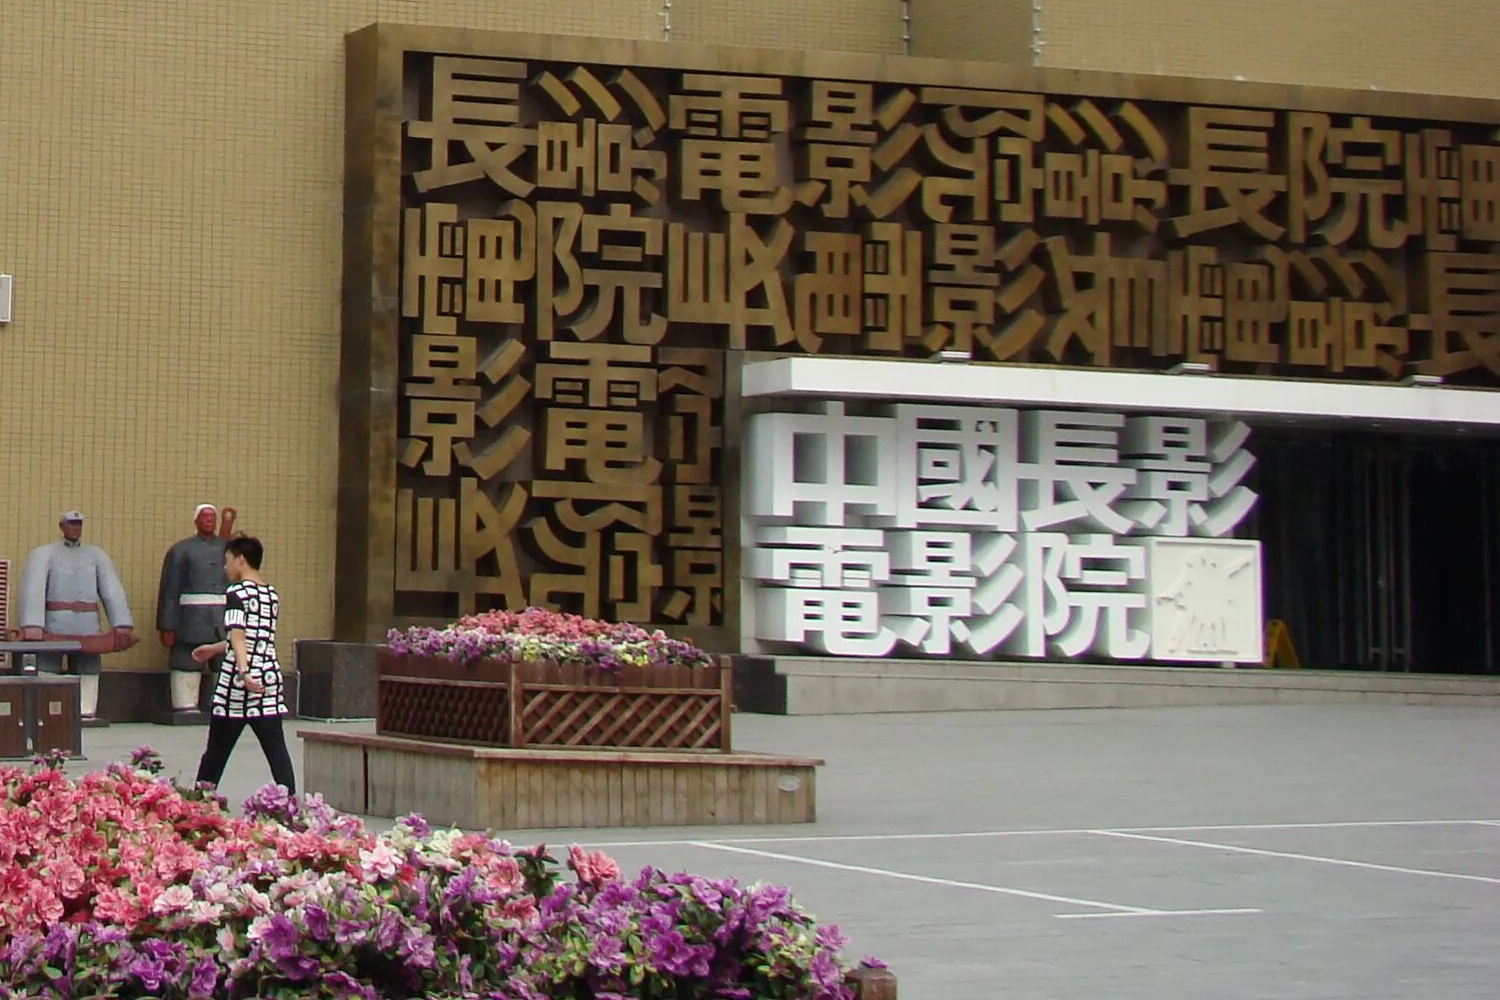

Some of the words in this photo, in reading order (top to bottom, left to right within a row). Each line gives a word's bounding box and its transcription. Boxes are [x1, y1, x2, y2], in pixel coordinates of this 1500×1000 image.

[772, 400, 1258, 537] 中國長影
[772, 526, 1150, 659] 電影院
